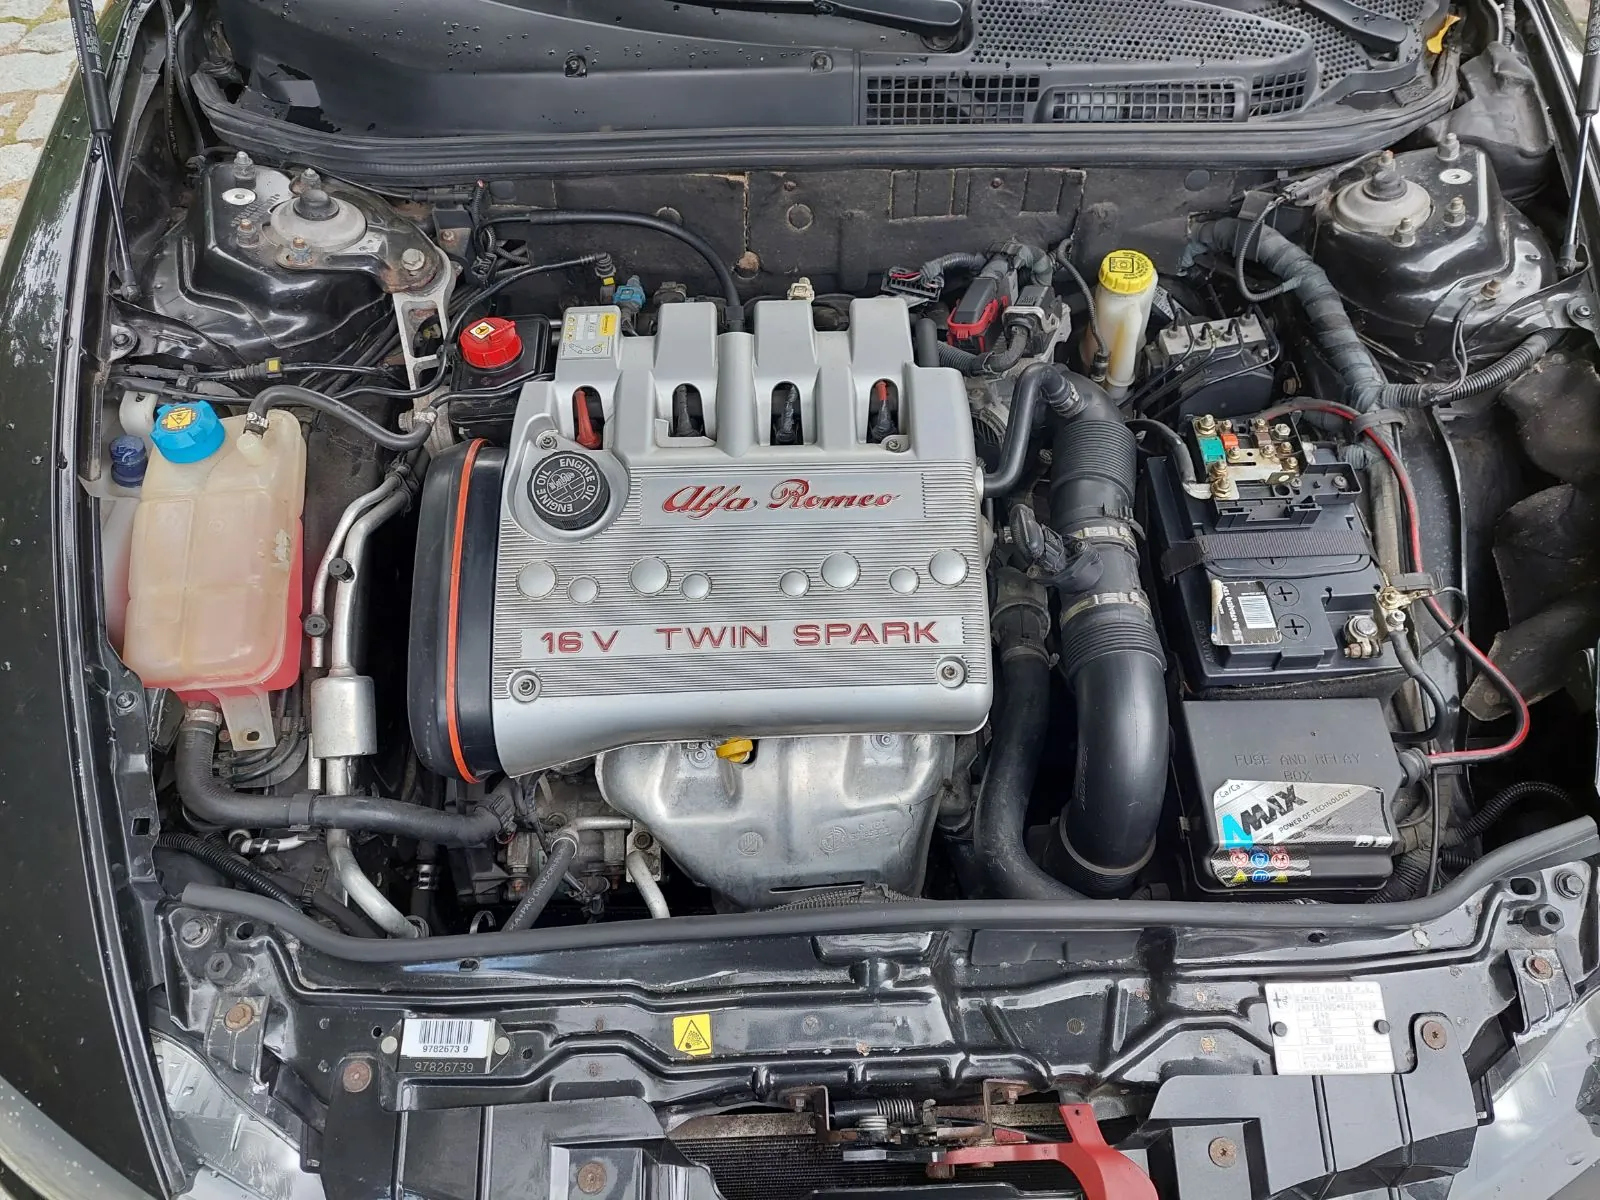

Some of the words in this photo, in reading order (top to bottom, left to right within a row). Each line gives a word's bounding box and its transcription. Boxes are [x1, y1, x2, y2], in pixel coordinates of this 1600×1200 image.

[536, 470, 552, 486] OIL
[559, 458, 596, 482] ENGINE
[581, 485, 596, 501] OIL
[536, 489, 573, 513] ENGINE
[661, 484, 758, 520] Alfa
[766, 478, 901, 511] Romeo
[655, 624, 769, 650] TWIN
[793, 620, 940, 647] SPARK
[1234, 754, 1270, 767] FUSE
[1280, 753, 1307, 766] AND
[1283, 770, 1313, 782] BOX
[1278, 815, 1303, 834] POWER
[1302, 811, 1313, 821] OF
[1311, 788, 1352, 814] TECHNOLOGY
[414, 1061, 474, 1073] 97826739
